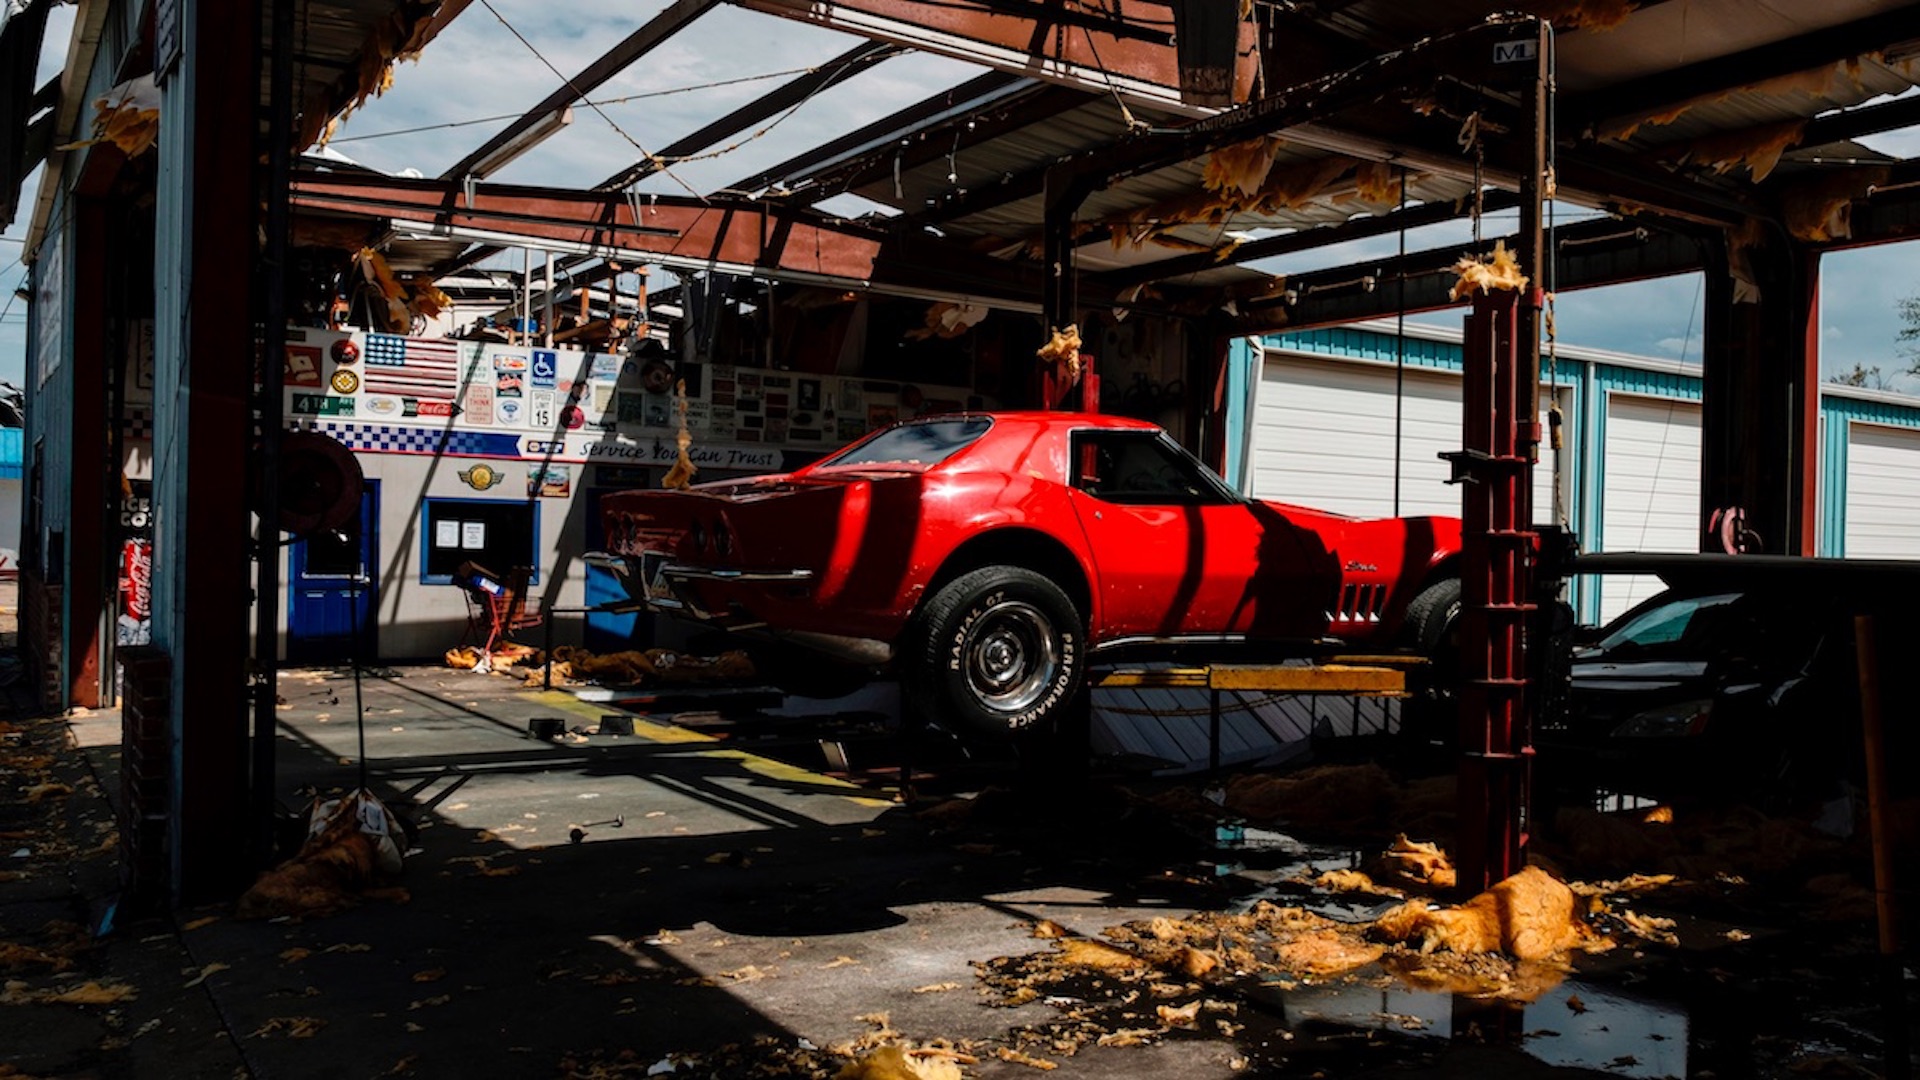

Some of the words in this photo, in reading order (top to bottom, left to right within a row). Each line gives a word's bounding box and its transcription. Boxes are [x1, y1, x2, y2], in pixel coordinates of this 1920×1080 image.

[1496, 43, 1535, 61] ML
[1257, 96, 1287, 116] LIFTS
[469, 398, 491, 406] THINK
[535, 393, 551, 401] SPEED
[535, 410, 549, 425] 15
[580, 441, 647, 459] Service
[653, 443, 679, 458] You
[689, 447, 722, 462] Can
[728, 450, 773, 465] Trust
[121, 497, 150, 511] ICE
[950, 607, 982, 671] RADIAL
[985, 591, 1005, 607] GT
[1008, 632, 1074, 729] PERFORMANCE
